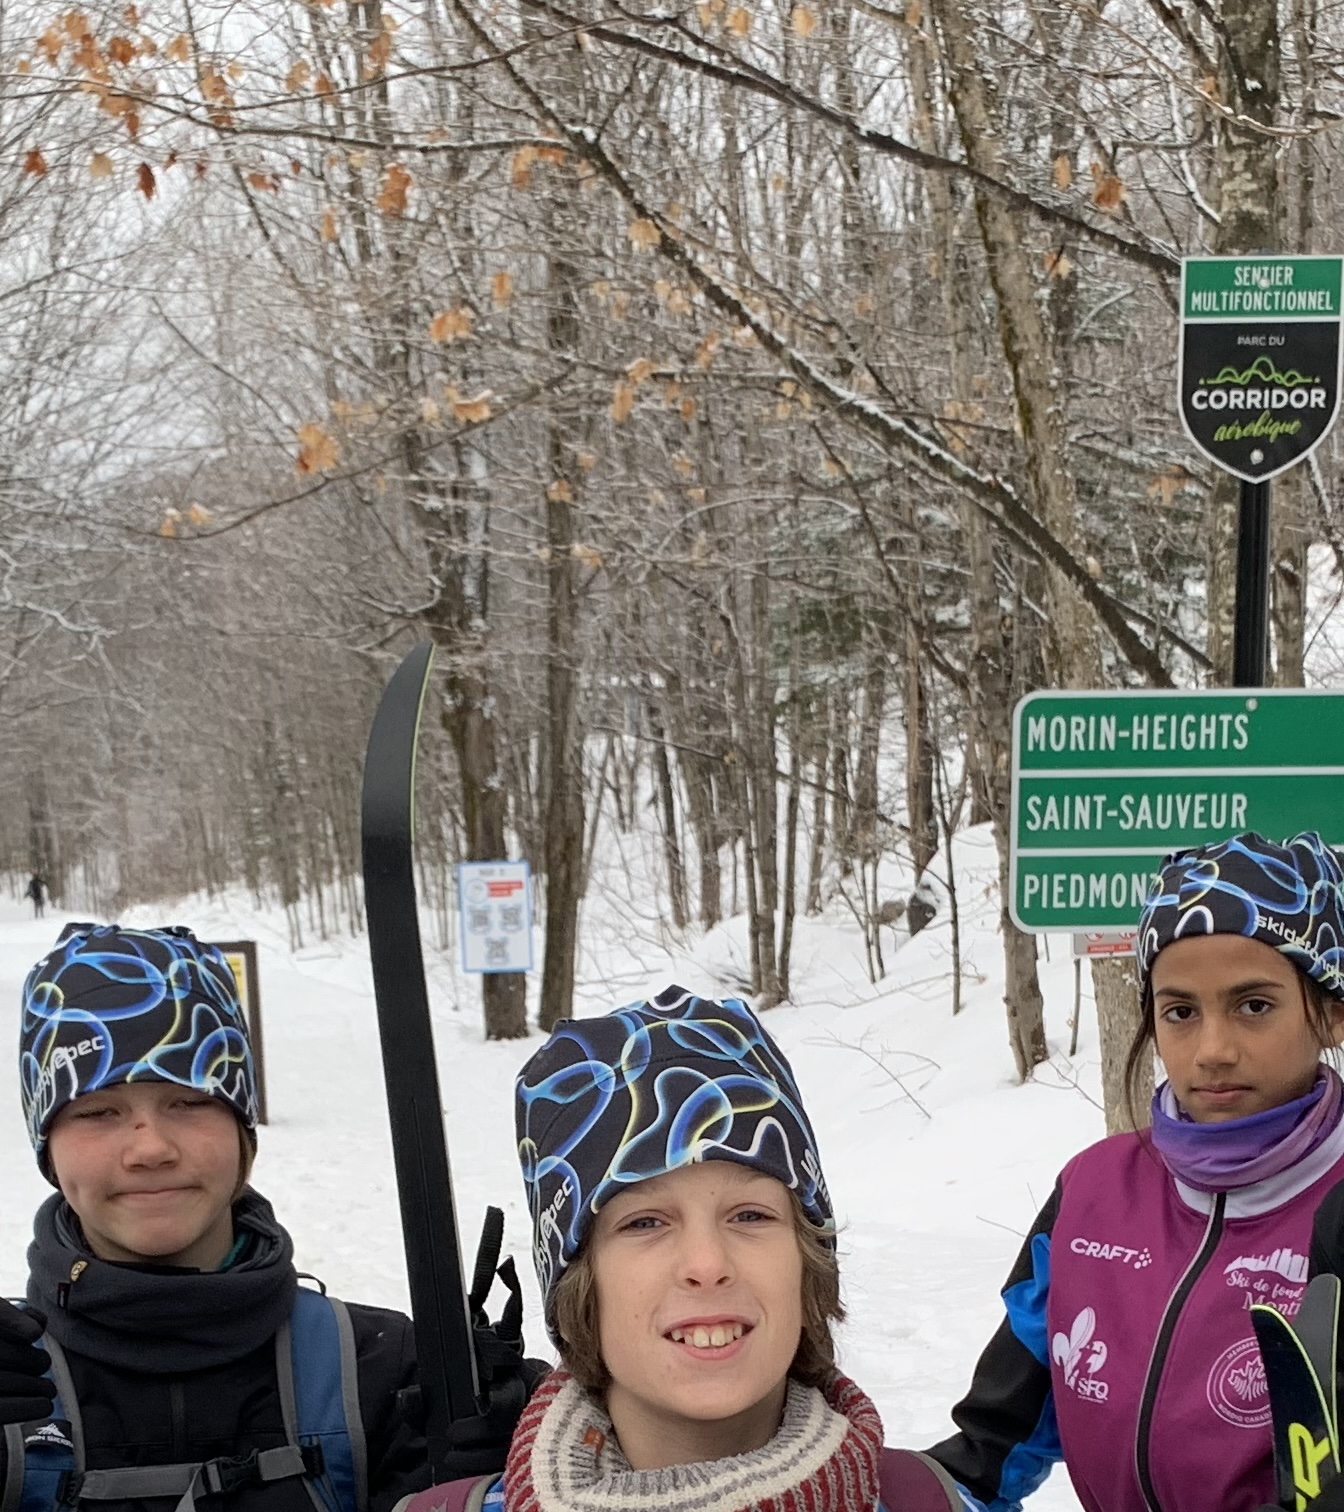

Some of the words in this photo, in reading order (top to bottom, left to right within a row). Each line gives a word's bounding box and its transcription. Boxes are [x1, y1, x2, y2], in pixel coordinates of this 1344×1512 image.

[1234, 266, 1294, 287] SENTIER
[1191, 290, 1334, 312] MULTIFONCTIONNEL
[1237, 335, 1266, 346] PARC
[1268, 335, 1286, 346] DU
[1191, 388, 1327, 410] CORRIDOR
[1213, 409, 1302, 444] aérobique
[1027, 714, 1249, 752] MORIN-HEIGHTS
[1026, 793, 1248, 831] SAINT-SAUVEUR
[1023, 872, 1160, 909] PIEDMON
[1070, 1238, 1138, 1263] CRAFT
[1226, 1270, 1250, 1288] Ski
[1253, 1277, 1269, 1292] de
[1271, 1281, 1304, 1300] fond
[1077, 1378, 1109, 1400] SFQ
